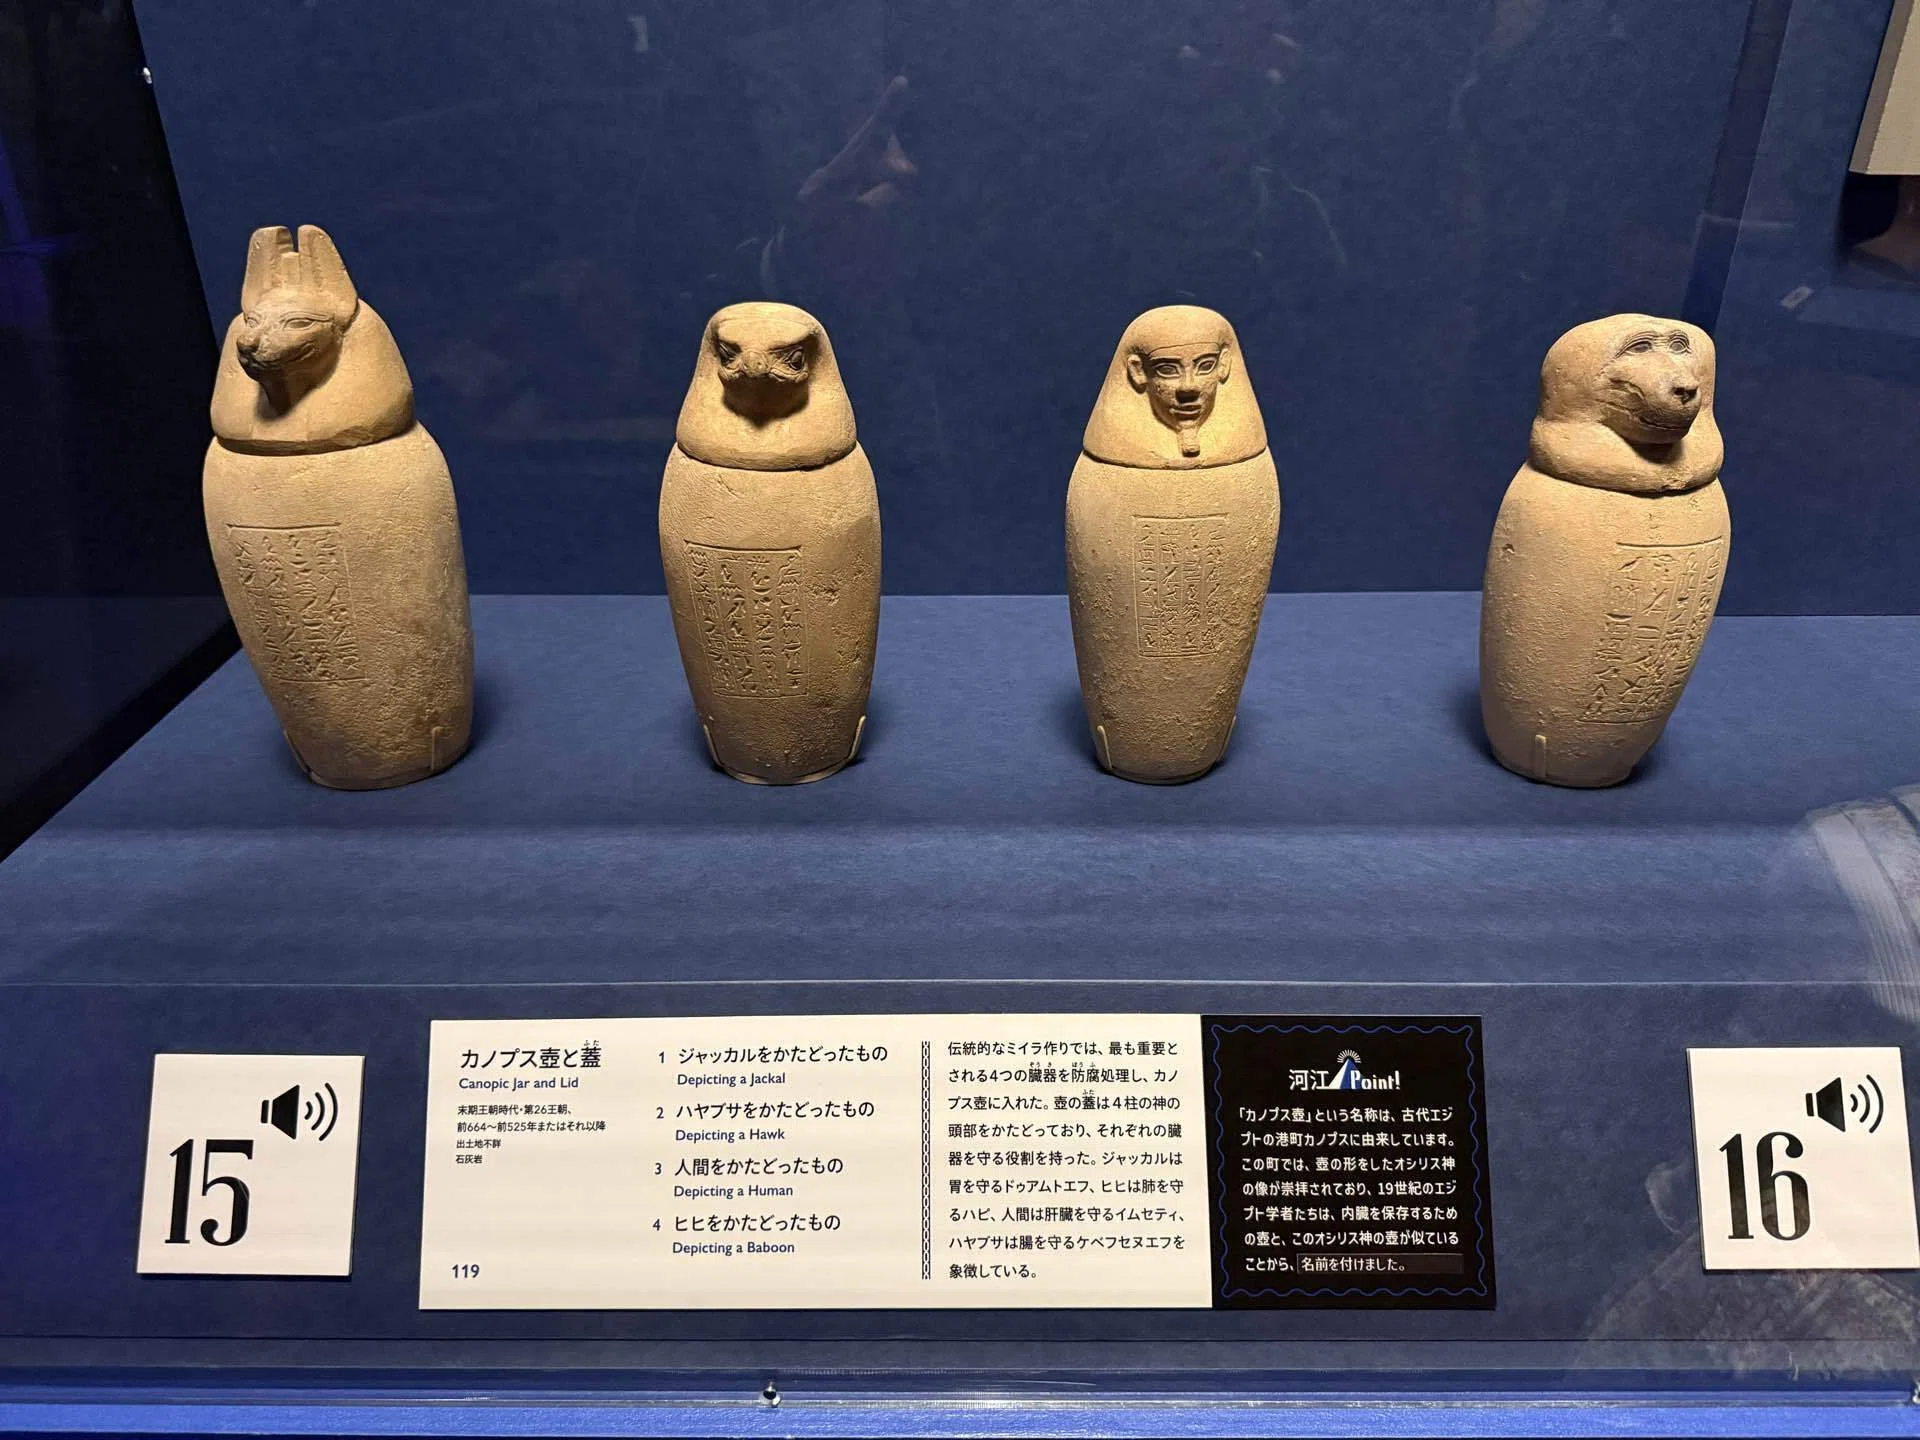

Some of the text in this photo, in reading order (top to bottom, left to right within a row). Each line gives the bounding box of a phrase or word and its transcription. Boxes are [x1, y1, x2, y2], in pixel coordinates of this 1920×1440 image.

[658, 1046, 888, 1064] 1 ジャッカルをかたどったもの
[948, 1041, 1177, 1056] 伝統的なミイラ作りでは、最も重要と
[460, 1047, 601, 1069] カノプス壺と蓋
[677, 1072, 785, 1088] Depicting a Jackal
[948, 1068, 1178, 1083] される4つの臓器を防腐処理し、カノ
[1289, 1069, 1401, 1091] 河江 Point!
[459, 1077, 578, 1092] Canopic Jar and Lid
[656, 1101, 874, 1120] 2 ハヤブサをかたどったもの
[1240, 1107, 1452, 1122] 「カノプス壺」という名称は、古代エジ
[675, 1128, 785, 1144] Depicting a Hawk
[948, 1123, 1182, 1138] 頭部をかたどっており、それぞれの臓
[456, 1139, 501, 1149] 出土地不詳
[1241, 1131, 1454, 1146] プトの港町カノプスに由来しています。
[456, 1154, 483, 1164] 石灰岩
[948, 1150, 1183, 1166] 器を守る役割を持った。ジャッカルは
[1243, 1156, 1455, 1171] この町では、壺の形をしたオシリス神
[655, 1157, 843, 1176] 3 人間をかたどったもの
[164, 1139, 254, 1246] 15
[674, 1185, 793, 1200] Depicting a Human
[949, 1179, 1183, 1194] 胃を守るドゥアムトエフ、ヒヒは肺を守
[1243, 1180, 1456, 1196] の像が崇拝されており、19世紀のエジ
[1719, 1131, 1810, 1241] 16
[950, 1206, 1184, 1223] るハピ、人間は肝臓を守るイムセティ、
[1244, 1206, 1457, 1221] プト学者たちは、内臓を保存するため
[652, 1214, 840, 1232] 4 ヒヒをかたどったもの
[1245, 1230, 1458, 1245] の壺と、このオシリス神の壺が似ている
[673, 1241, 795, 1256] Depicting a Baboon
[452, 1264, 480, 1278] 119
[949, 1264, 1036, 1280] 象徴している。
